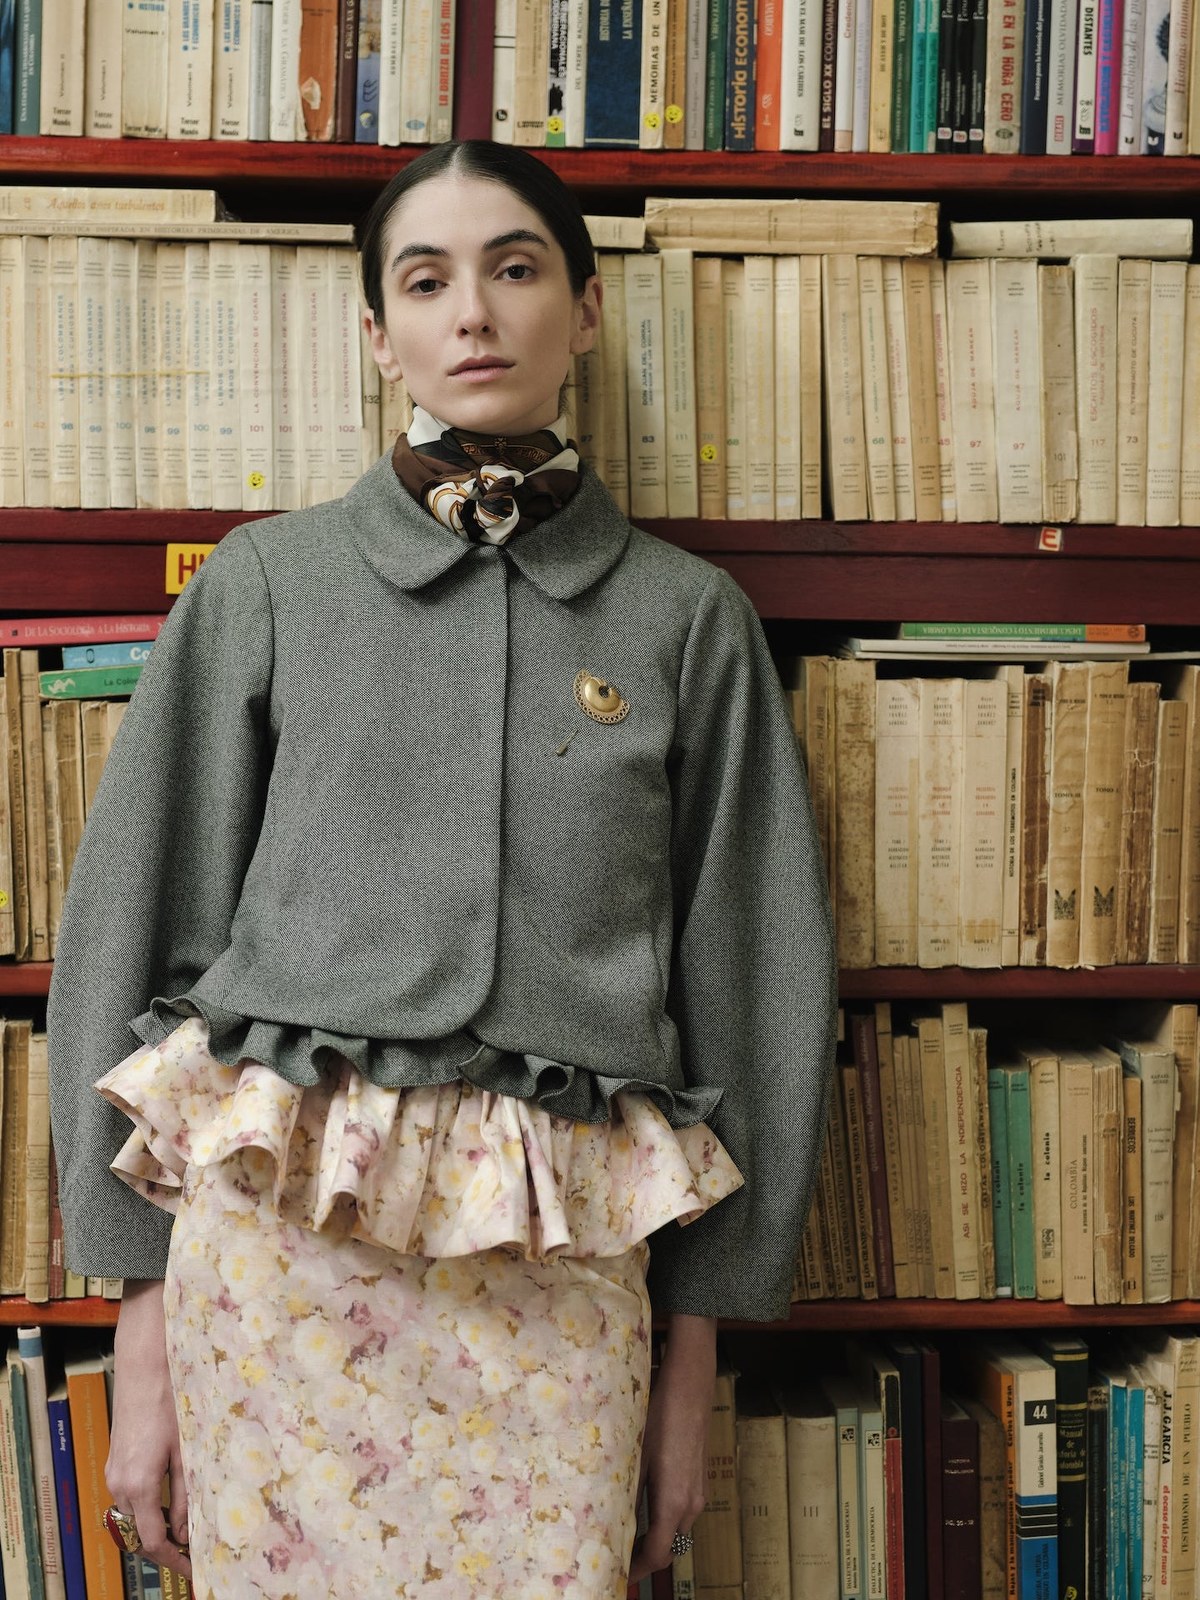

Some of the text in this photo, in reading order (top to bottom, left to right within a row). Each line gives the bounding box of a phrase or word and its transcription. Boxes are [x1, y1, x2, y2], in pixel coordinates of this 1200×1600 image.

[223, 2, 232, 43] LOS GRANDES
[439, 22, 451, 40] LOS
[1083, 6, 1095, 56] DISTANTES
[344, 48, 353, 60] EL
[650, 1, 661, 104] MEMORIAS DE UN
[823, 63, 834, 77] XX
[1000, 14, 1015, 122] EN LA HORA CERO
[1055, 53, 1066, 106] MEMORIAS
[1173, 43, 1187, 95] Historias
[438, 94, 449, 107] LA
[822, 78, 834, 113] SIGLO
[821, 115, 832, 129] EL
[57, 294, 65, 362] COLOMBIANOS
[216, 299, 225, 408] LIBROS COLOMBIANOS
[250, 291, 260, 415] LA CONVENCION DE OCAÑA
[640, 320, 649, 406] DON JUAN DEL CORRAL
[1089, 306, 1099, 422] ESCRITOS ESCOGIDOS
[969, 367, 977, 378] DE
[115, 421, 132, 430] 100
[249, 424, 265, 433] 101
[279, 424, 293, 433] 101
[308, 424, 323, 432] 101
[338, 424, 356, 433] 102
[641, 434, 655, 443] 83
[872, 436, 885, 445] 68
[969, 439, 982, 448] 97
[1012, 441, 1026, 451] 97
[1126, 435, 1139, 445] 73
[1041, 527, 1058, 549] E
[25, 626, 36, 637] DE
[37, 626, 48, 637] LA
[103, 625, 115, 635] LA
[115, 623, 151, 635] HISTORIA
[922, 625, 962, 635] COLOMBIA
[972, 625, 1013, 635] CONQUISTA
[1017, 625, 1082, 636] DESCUBRIMIENTO
[1010, 767, 1018, 793] COLOMBIA
[1009, 802, 1017, 834] TERREMOTOS
[1008, 855, 1016, 878] HISTORIA
[886, 1094, 900, 1203] VIEJAS ESTAMPAS
[1127, 1117, 1137, 1154] BERRUECOS
[954, 1066, 971, 1239] ASI SE HIZO LA INDEPENDENCIA
[978, 1102, 989, 1209] CARTAS COLOMBIANAS
[1043, 1131, 1051, 1181] la colonia
[837, 1172, 849, 1218] CONFLICTOS
[848, 1087, 871, 1279] LOS GRANDES CONFLICTOS DE NUESTRA HISTORIA
[992, 1160, 1002, 1209] la colonia
[1016, 1162, 1025, 1211] la colonia
[1069, 1159, 1078, 1210] COLOMBIA
[841, 1219, 852, 1257] GRANDES
[1128, 1195, 1136, 1258] LUIS MARTINEZ DELGADO
[1032, 1404, 1048, 1420] 44
[57, 1419, 67, 1452] Jorge Child
[1005, 1416, 1014, 1448] Carlos
[1059, 1429, 1084, 1440] Manual
[1006, 1460, 1015, 1487] poder
[1036, 1431, 1045, 1489] Gabriel Giraldo Jaramillo
[1006, 1487, 1014, 1499] del
[1162, 1485, 1170, 1494] el
[1180, 1403, 1192, 1556] TESTIMONIO DE UN PUEBLO
[1162, 1495, 1170, 1522] ocaso
[38, 1475, 58, 1576] Historias mínimas
[1161, 1523, 1170, 1534] de
[1160, 1534, 1171, 1554] josé
[870, 1561, 878, 1594] DIALECTICA
[1008, 1572, 1017, 1596] Rojas
